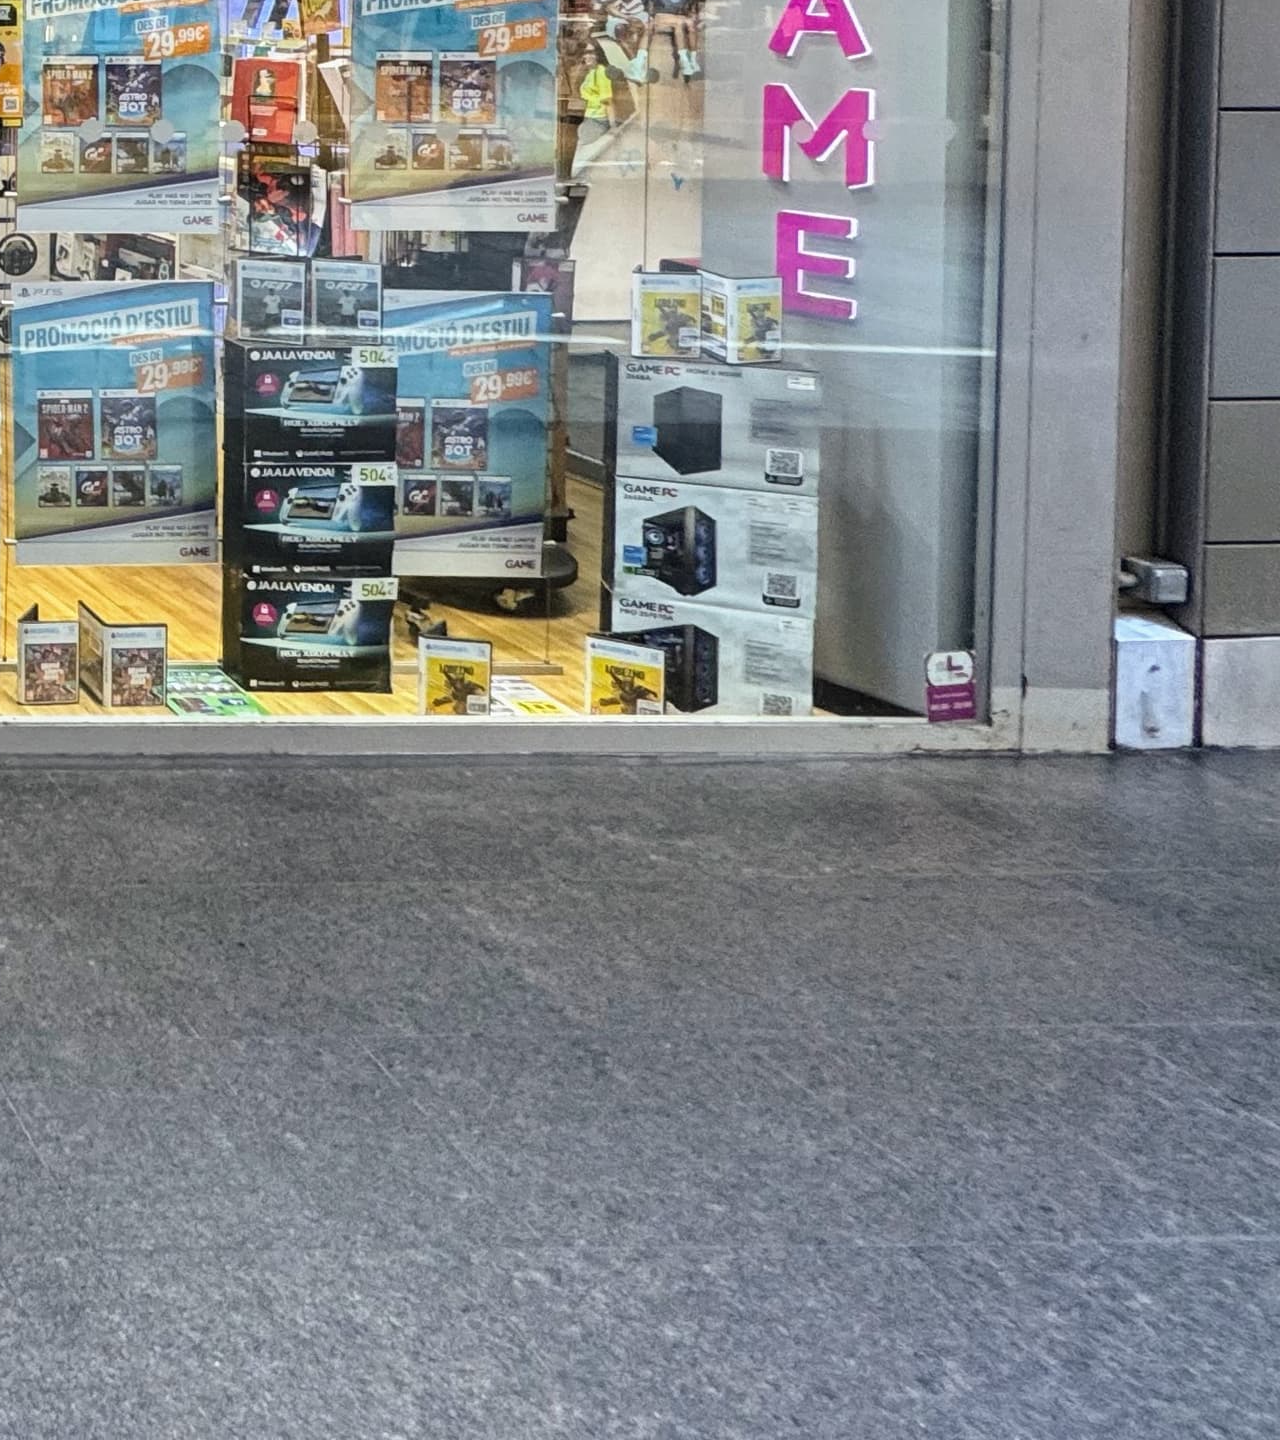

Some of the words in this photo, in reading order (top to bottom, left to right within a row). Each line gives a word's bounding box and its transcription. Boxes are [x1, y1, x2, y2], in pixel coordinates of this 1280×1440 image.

[119, 101, 148, 112] BOT
[453, 97, 481, 109] BOT
[183, 216, 213, 225] GAME
[517, 213, 548, 223] GAME
[24, 313, 121, 348] PROMOCIÓ
[126, 305, 192, 332] D'ESTIU
[463, 317, 530, 343] D'ESTIU
[297, 350, 335, 360] VENDA!
[359, 351, 386, 363] 504
[626, 363, 664, 374] GAME
[665, 366, 680, 376] PC
[114, 434, 143, 445] BOT
[445, 444, 473, 456] BOT
[297, 468, 335, 478] VENDA!
[359, 468, 386, 481] 504
[623, 483, 661, 495] GAME
[661, 488, 678, 497] PC
[180, 547, 210, 557] GAME
[505, 559, 536, 569] GAME
[296, 580, 335, 592] VENDA!
[361, 584, 387, 596] 504
[619, 598, 657, 611] GAME
[658, 603, 674, 614] PC
